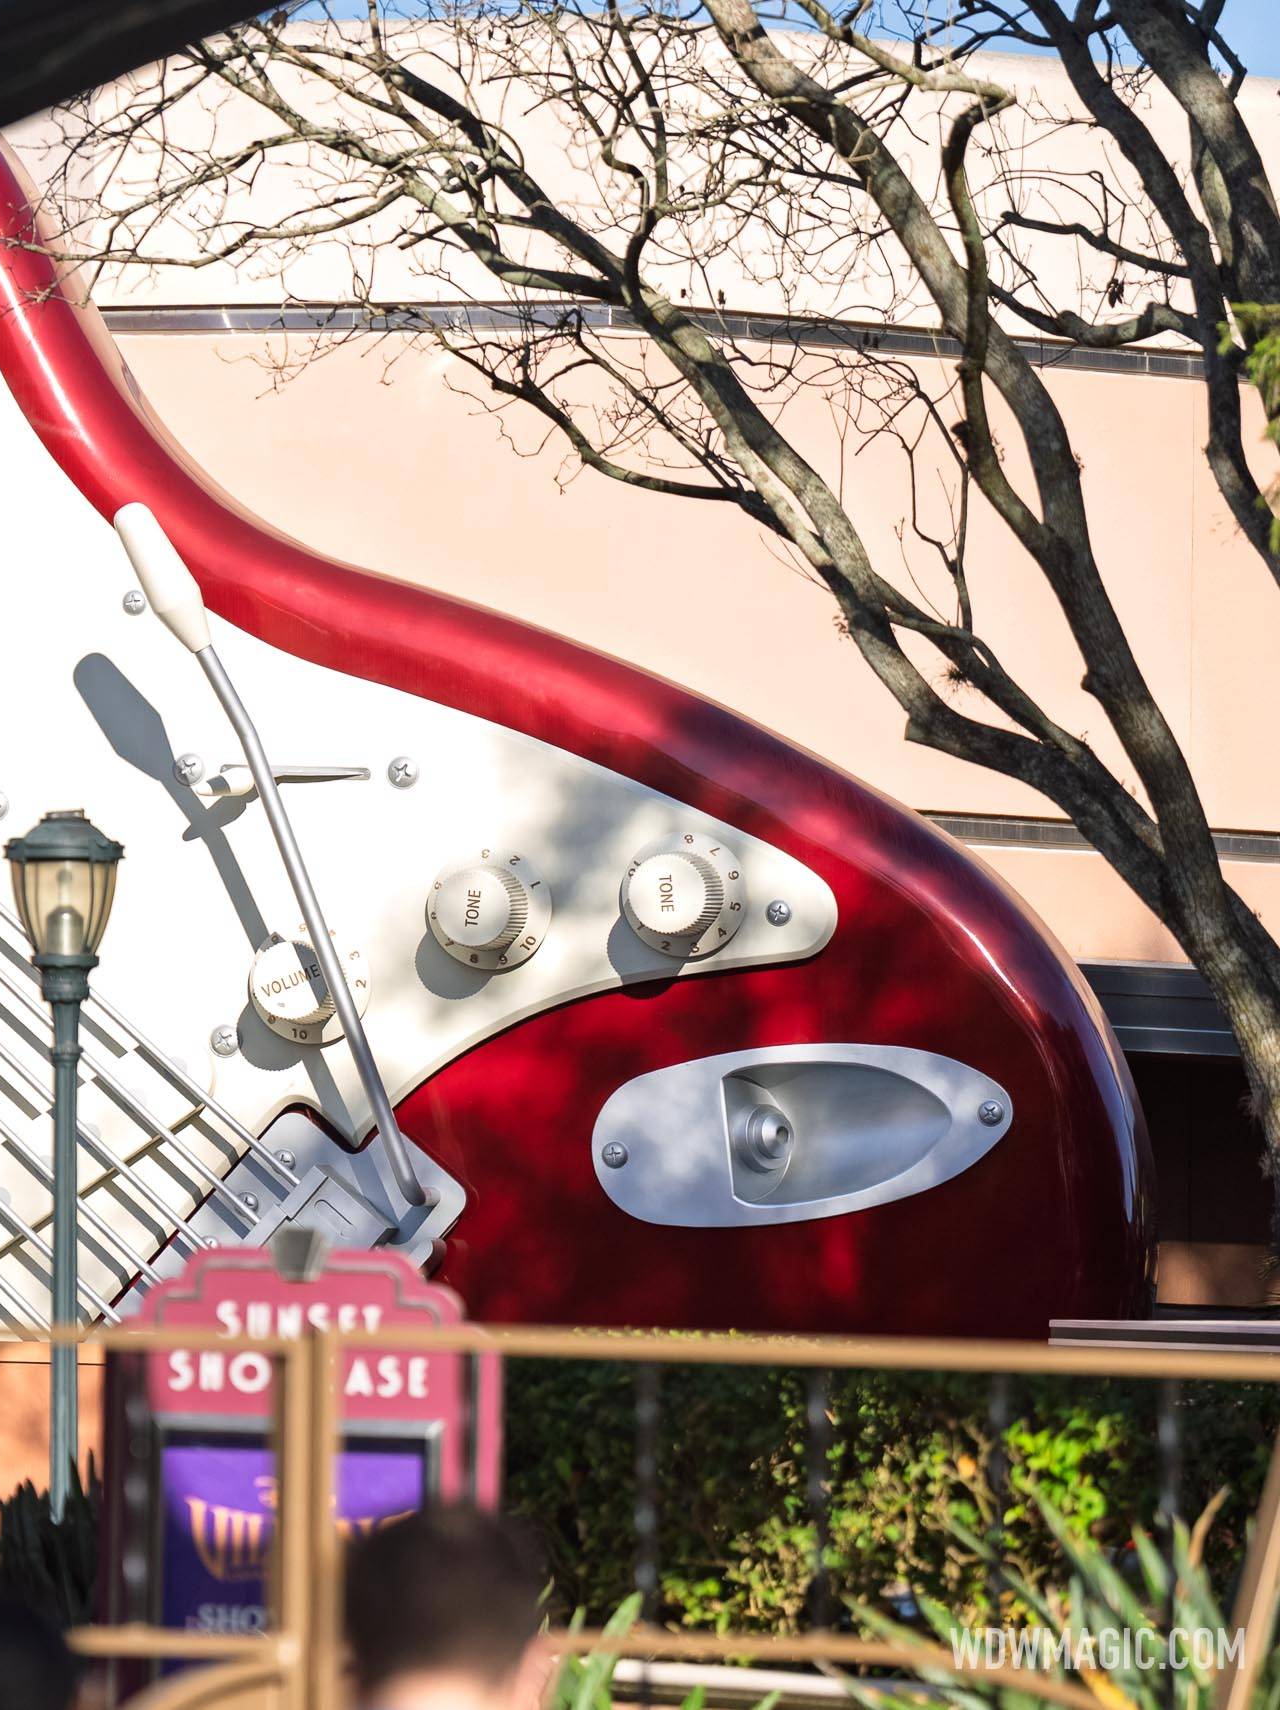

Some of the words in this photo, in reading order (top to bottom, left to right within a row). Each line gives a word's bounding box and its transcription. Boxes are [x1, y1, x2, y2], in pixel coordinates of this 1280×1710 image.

[465, 890, 481, 927] TONE
[659, 875, 675, 912] TONE
[520, 936, 537, 951] 10
[261, 964, 320, 997] VOLUME
[291, 1028, 308, 1040] 10
[216, 1300, 385, 1341] SUNSET
[167, 1349, 429, 1398] SHOASE
